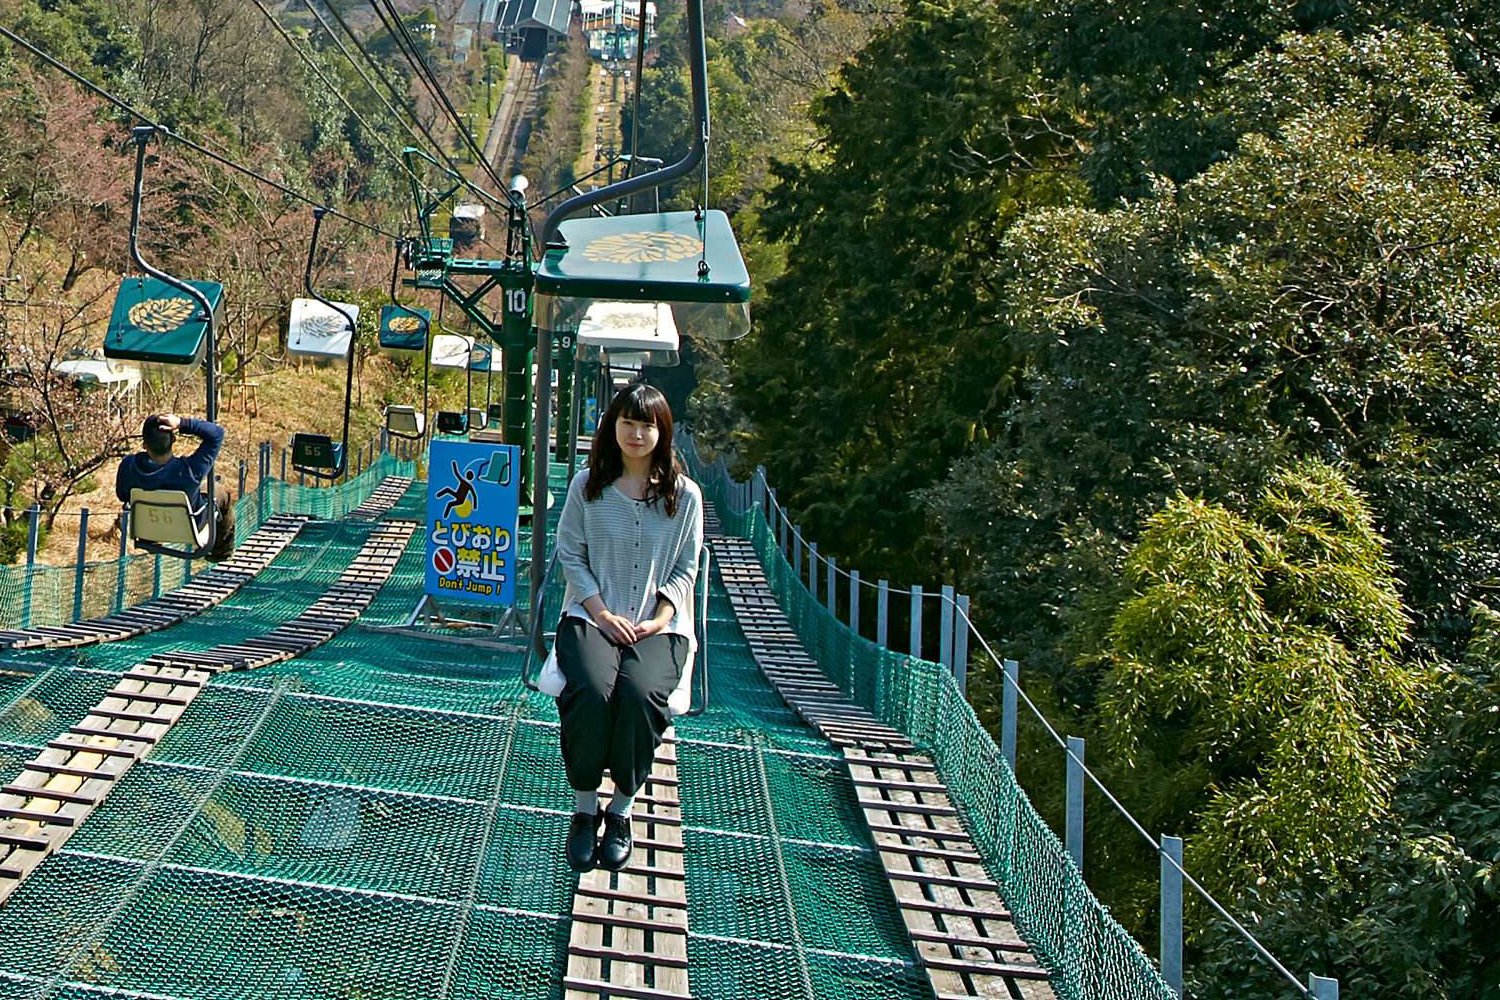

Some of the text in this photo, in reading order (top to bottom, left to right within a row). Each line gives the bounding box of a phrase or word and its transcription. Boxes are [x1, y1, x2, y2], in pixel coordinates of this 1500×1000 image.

[505, 289, 526, 313] 10
[561, 336, 571, 349] 9
[304, 445, 321, 457] 55
[148, 508, 173, 524] 56
[431, 520, 511, 552] とびおり
[456, 547, 505, 582] 禁止
[439, 576, 464, 590] Don't
[465, 580, 492, 595] Jump
